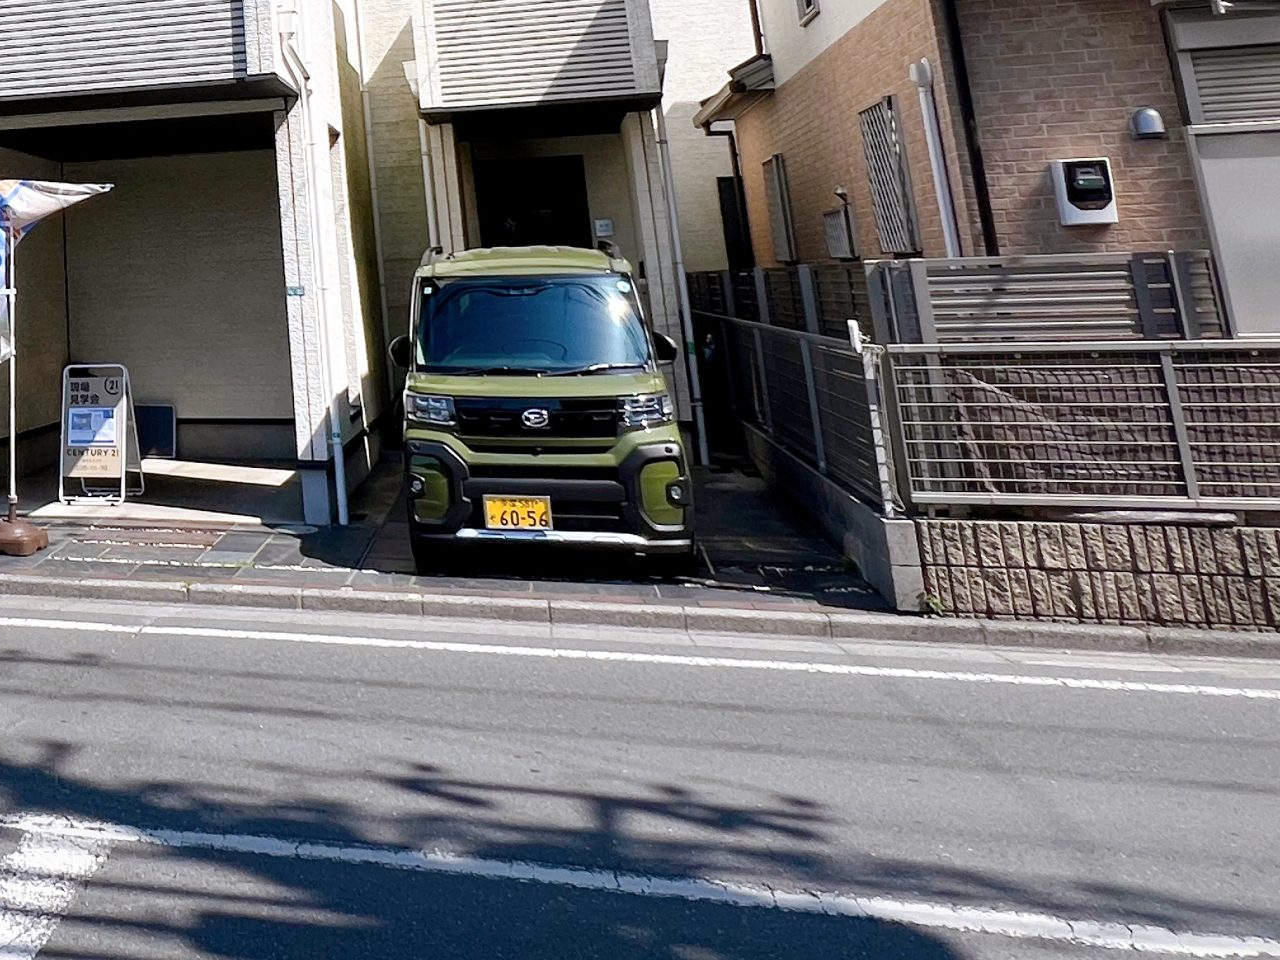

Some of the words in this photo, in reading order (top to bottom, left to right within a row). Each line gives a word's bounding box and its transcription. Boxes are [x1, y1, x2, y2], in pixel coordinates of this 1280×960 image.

[70, 394, 99, 405] 見学会
[66, 449, 108, 457] CENTURY
[111, 449, 119, 457] 21
[500, 510, 548, 527] 60-56
